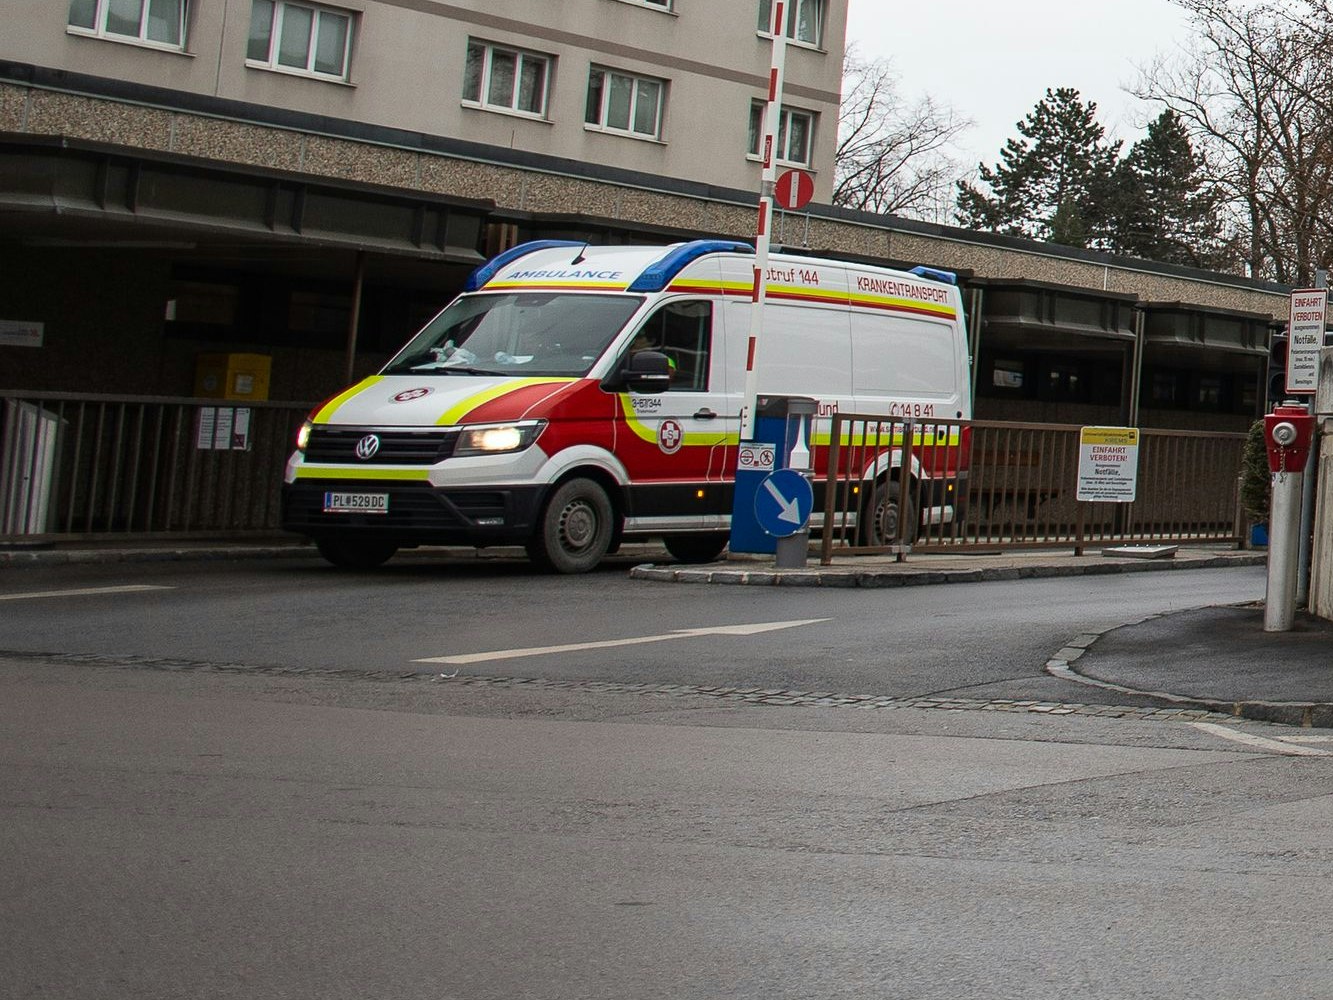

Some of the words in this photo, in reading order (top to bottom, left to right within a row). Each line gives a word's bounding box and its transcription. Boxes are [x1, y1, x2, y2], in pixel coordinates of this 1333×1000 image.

[507, 269, 624, 280] AMBULANCE
[798, 268, 820, 286] 144
[856, 276, 949, 304] KRANKENTRANSPORT
[1294, 297, 1323, 308] EINFAHRT
[1292, 311, 1323, 321] VERBOTEN
[1092, 446, 1126, 454] EINFAHRT
[1089, 454, 1128, 462] VERBOTEN!
